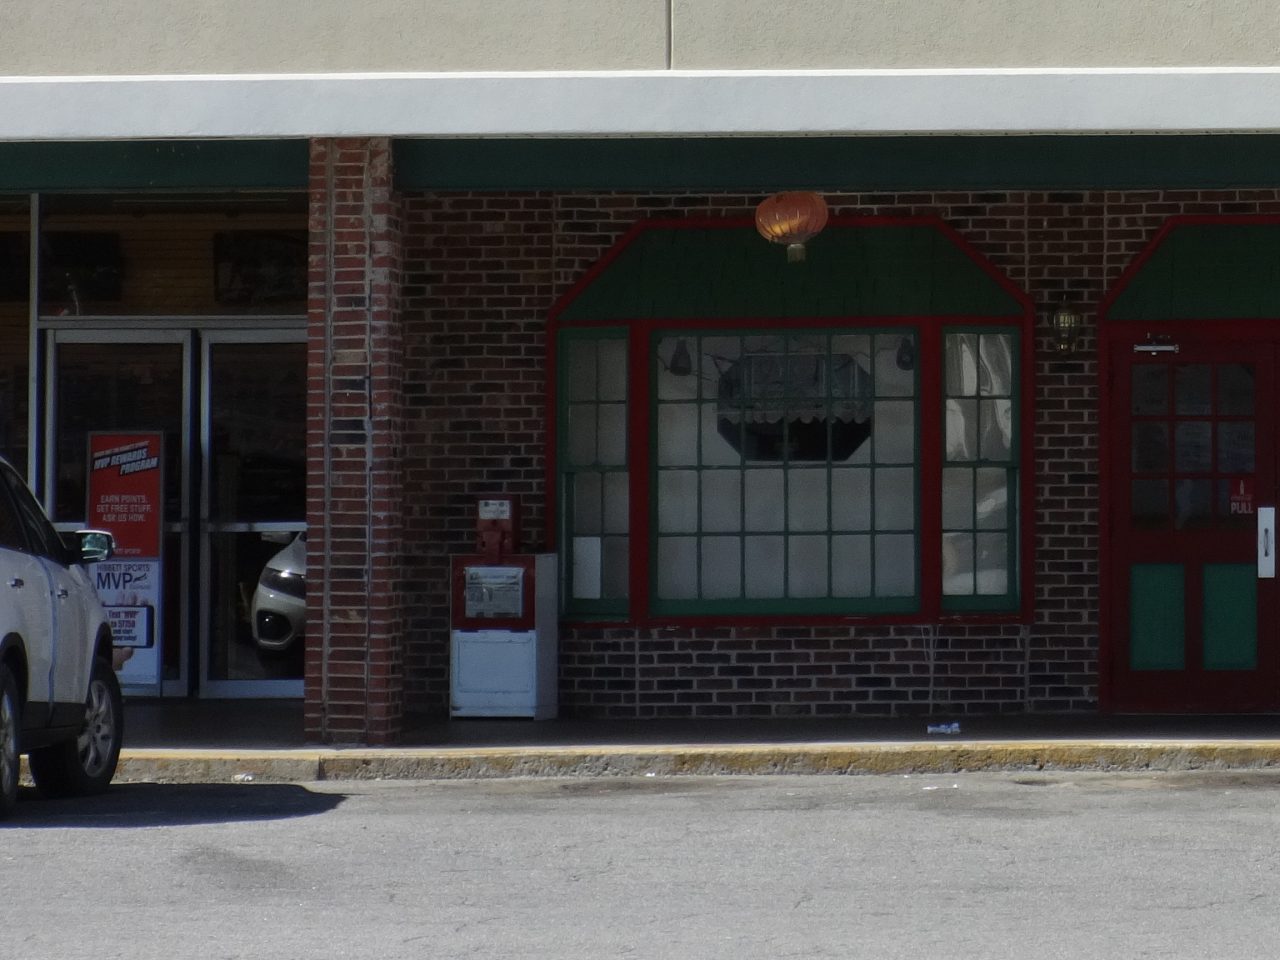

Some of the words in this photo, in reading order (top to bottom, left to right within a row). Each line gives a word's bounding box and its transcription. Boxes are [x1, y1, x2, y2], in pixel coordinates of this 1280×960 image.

[120, 457, 158, 475] PROGRAM
[100, 495, 119, 503] EARN
[96, 504, 109, 513] GET
[111, 504, 128, 513] FREE
[1230, 502, 1254, 514] PULL
[102, 513, 116, 522] ASK
[118, 513, 127, 522] US
[124, 564, 150, 572] SPORTS
[96, 572, 133, 590] MVP
